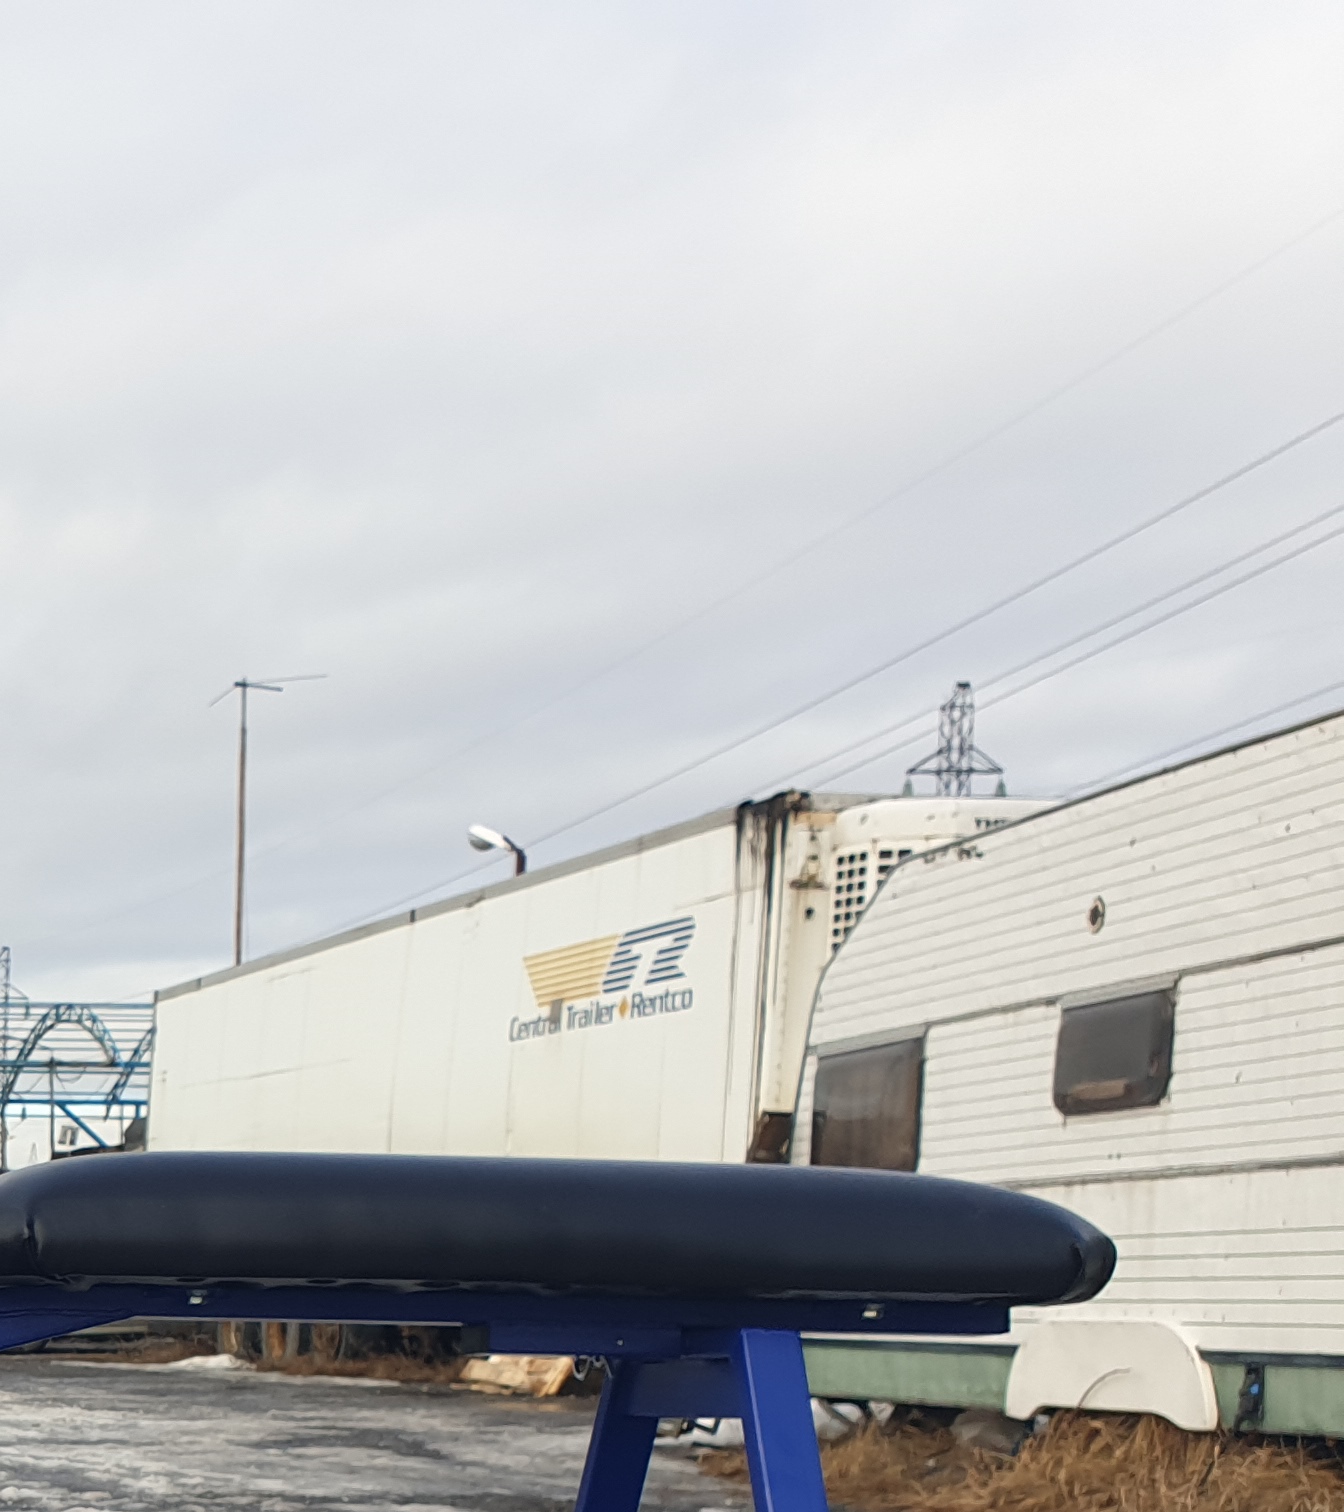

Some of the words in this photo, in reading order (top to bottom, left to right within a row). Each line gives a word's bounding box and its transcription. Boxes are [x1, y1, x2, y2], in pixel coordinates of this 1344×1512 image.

[509, 1005, 563, 1042] Central
[566, 1000, 616, 1031] Trailer
[629, 987, 694, 1018] Rentco
